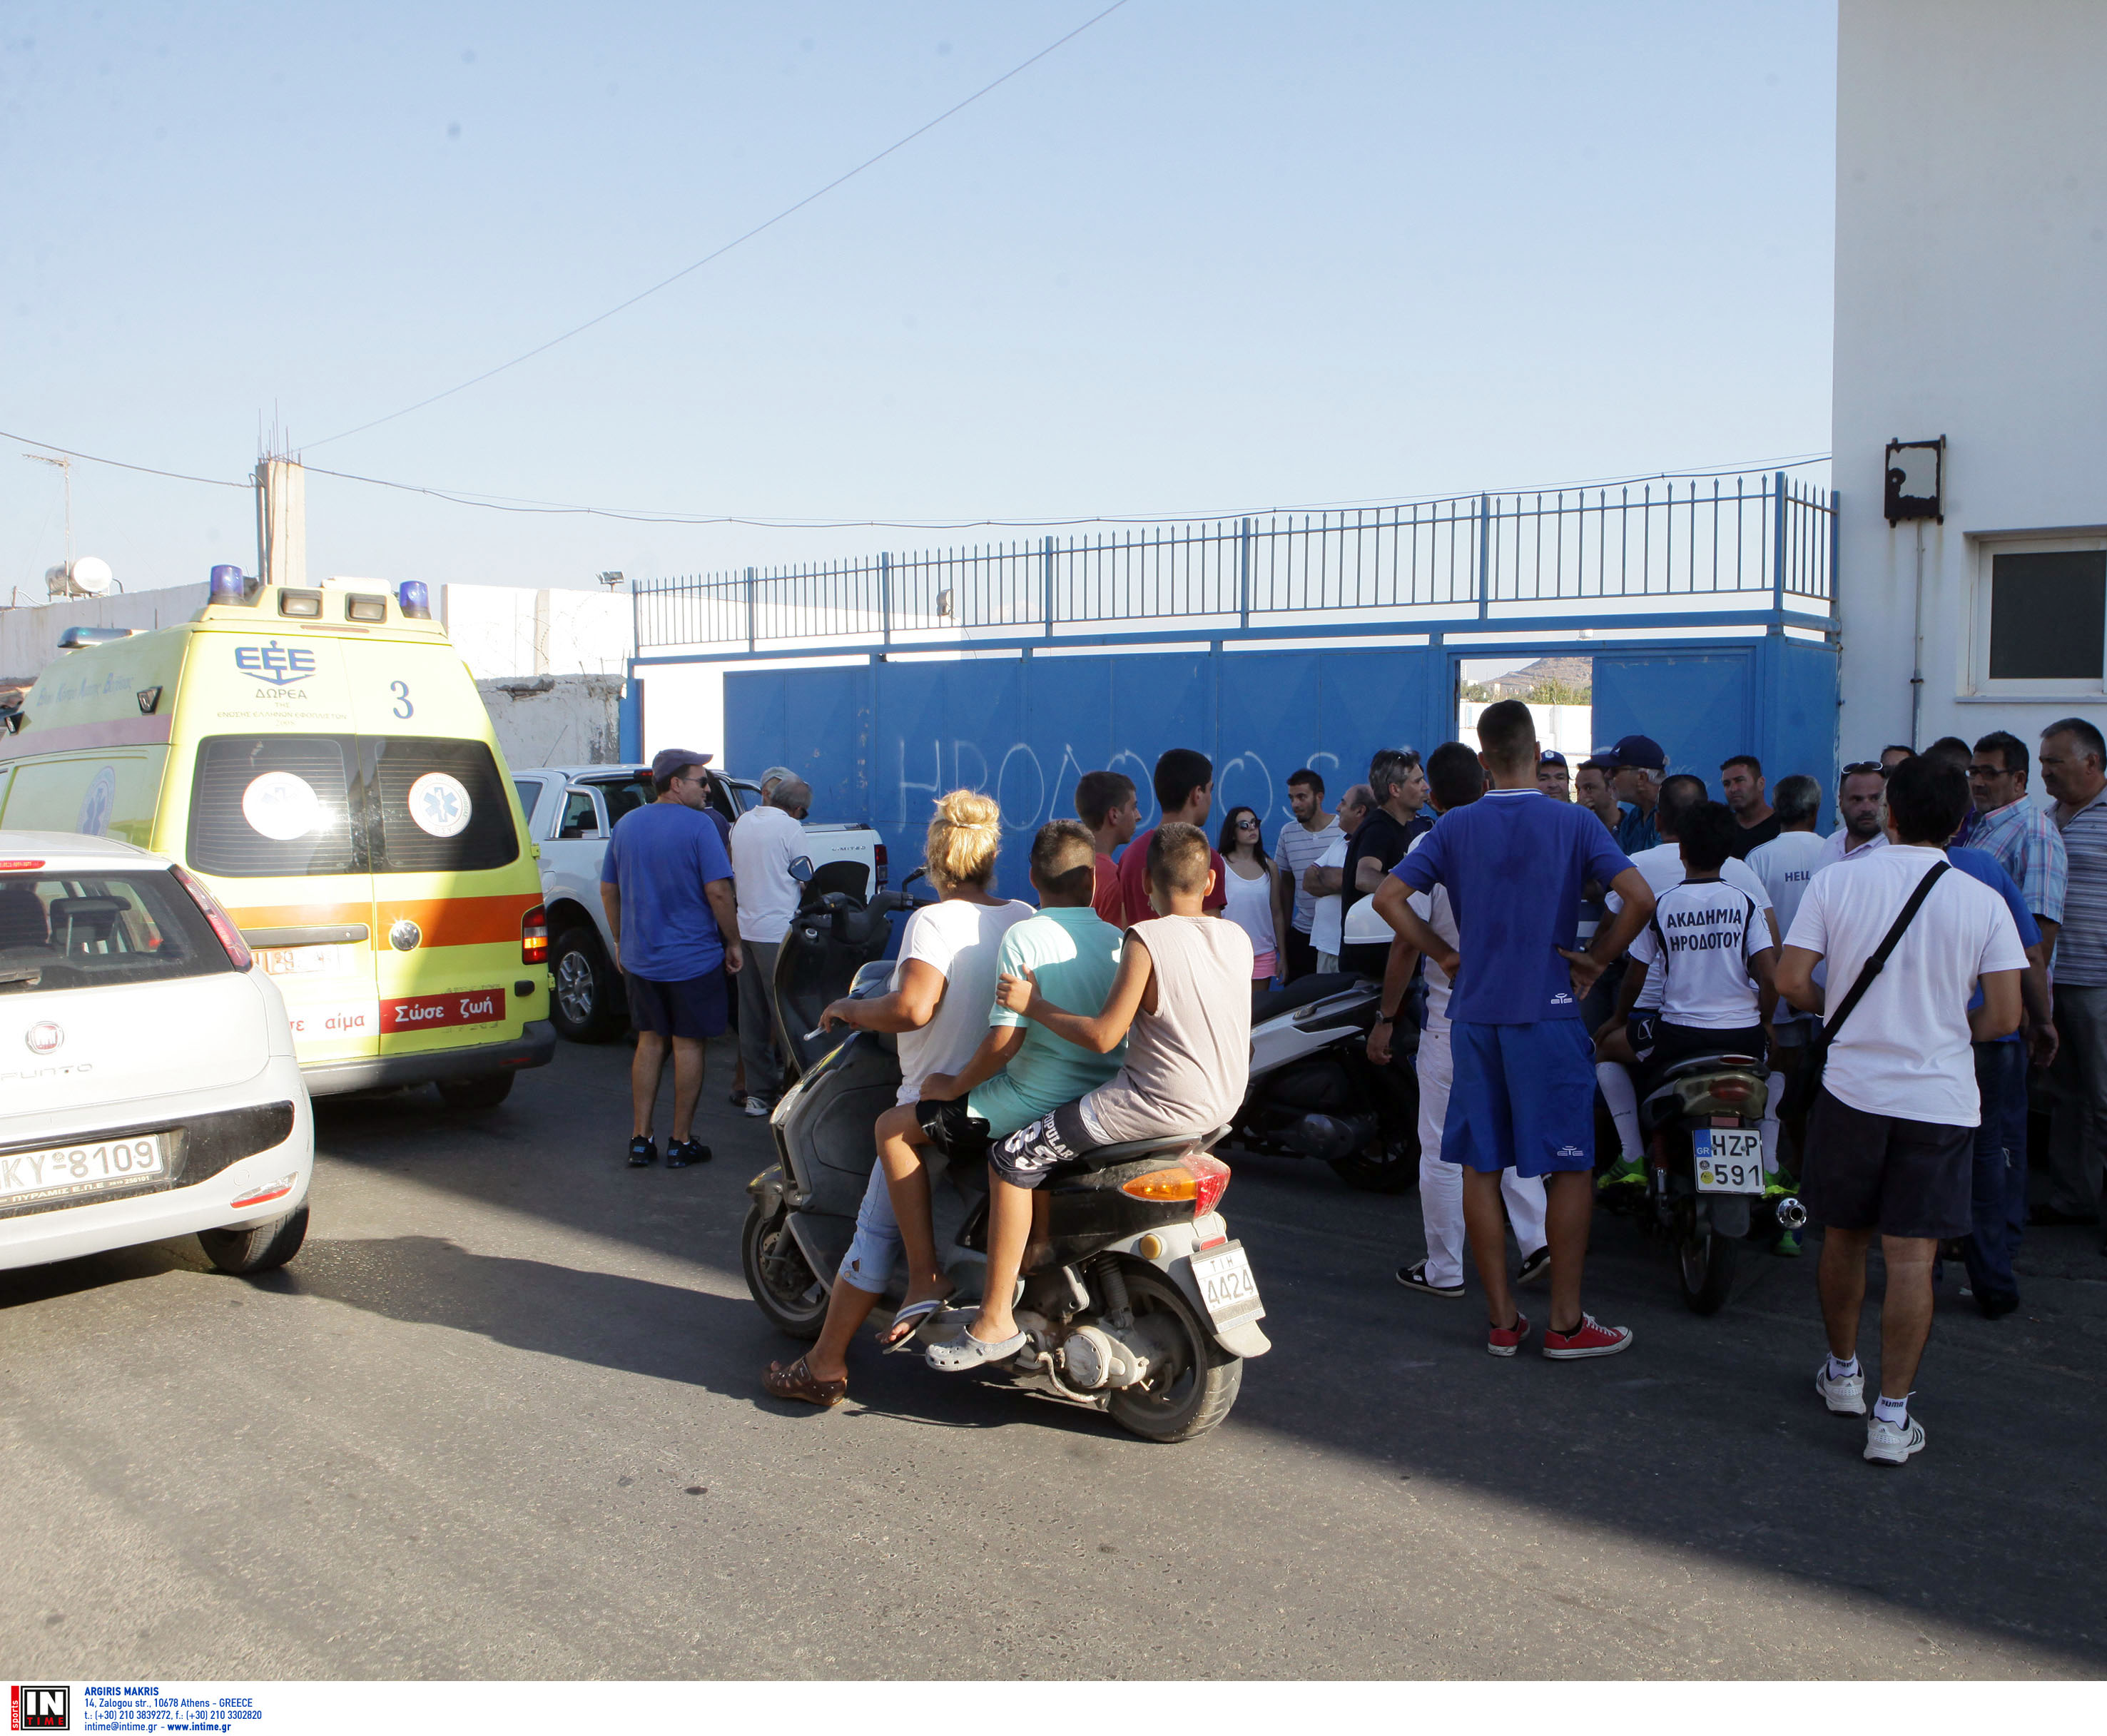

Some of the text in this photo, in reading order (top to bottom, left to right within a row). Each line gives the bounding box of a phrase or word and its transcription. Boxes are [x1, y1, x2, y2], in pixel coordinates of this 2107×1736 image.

[255, 689, 308, 700] ΔΩΡΕΑ
[390, 680, 414, 719] 3
[1667, 908, 1742, 928] ΑΚΑΔΗΜΙΑ
[1670, 932, 1741, 951] ΗΡΟΔΟΤΟΥ
[395, 996, 494, 1022] Σώσε ζωή
[325, 1012, 365, 1031] αίμα
[1, 1063, 93, 1081] PUNTO
[1044, 1110, 1075, 1159] POPULAR
[1697, 1135, 1758, 1157] GR HZP
[1715, 1164, 1760, 1187] 591
[12, 1187, 70, 1203] ΠΥΡΑΜΙΣ
[1208, 1269, 1254, 1304] 4424
